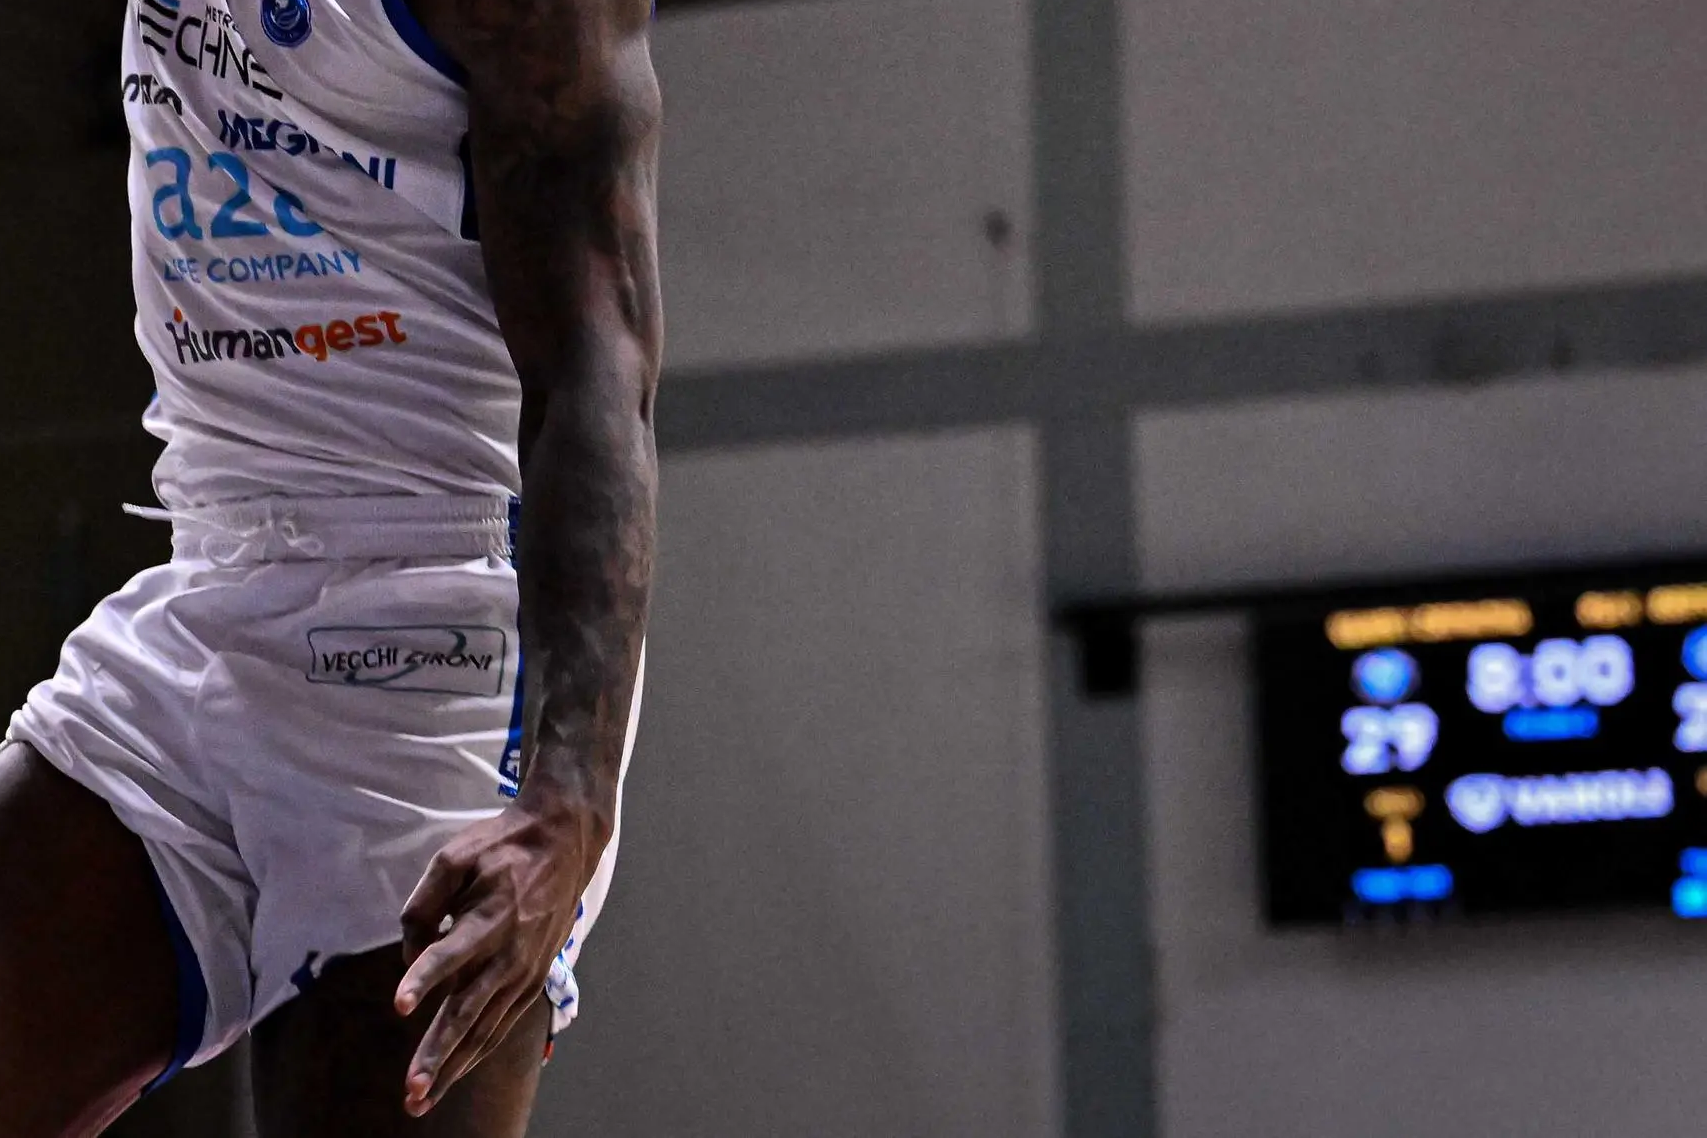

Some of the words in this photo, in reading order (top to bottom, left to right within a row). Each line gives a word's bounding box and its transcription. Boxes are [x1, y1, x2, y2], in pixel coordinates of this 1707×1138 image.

[206, 249, 361, 283] COMPANY
[165, 305, 407, 365] Humangest
[322, 647, 398, 672] VECCHI
